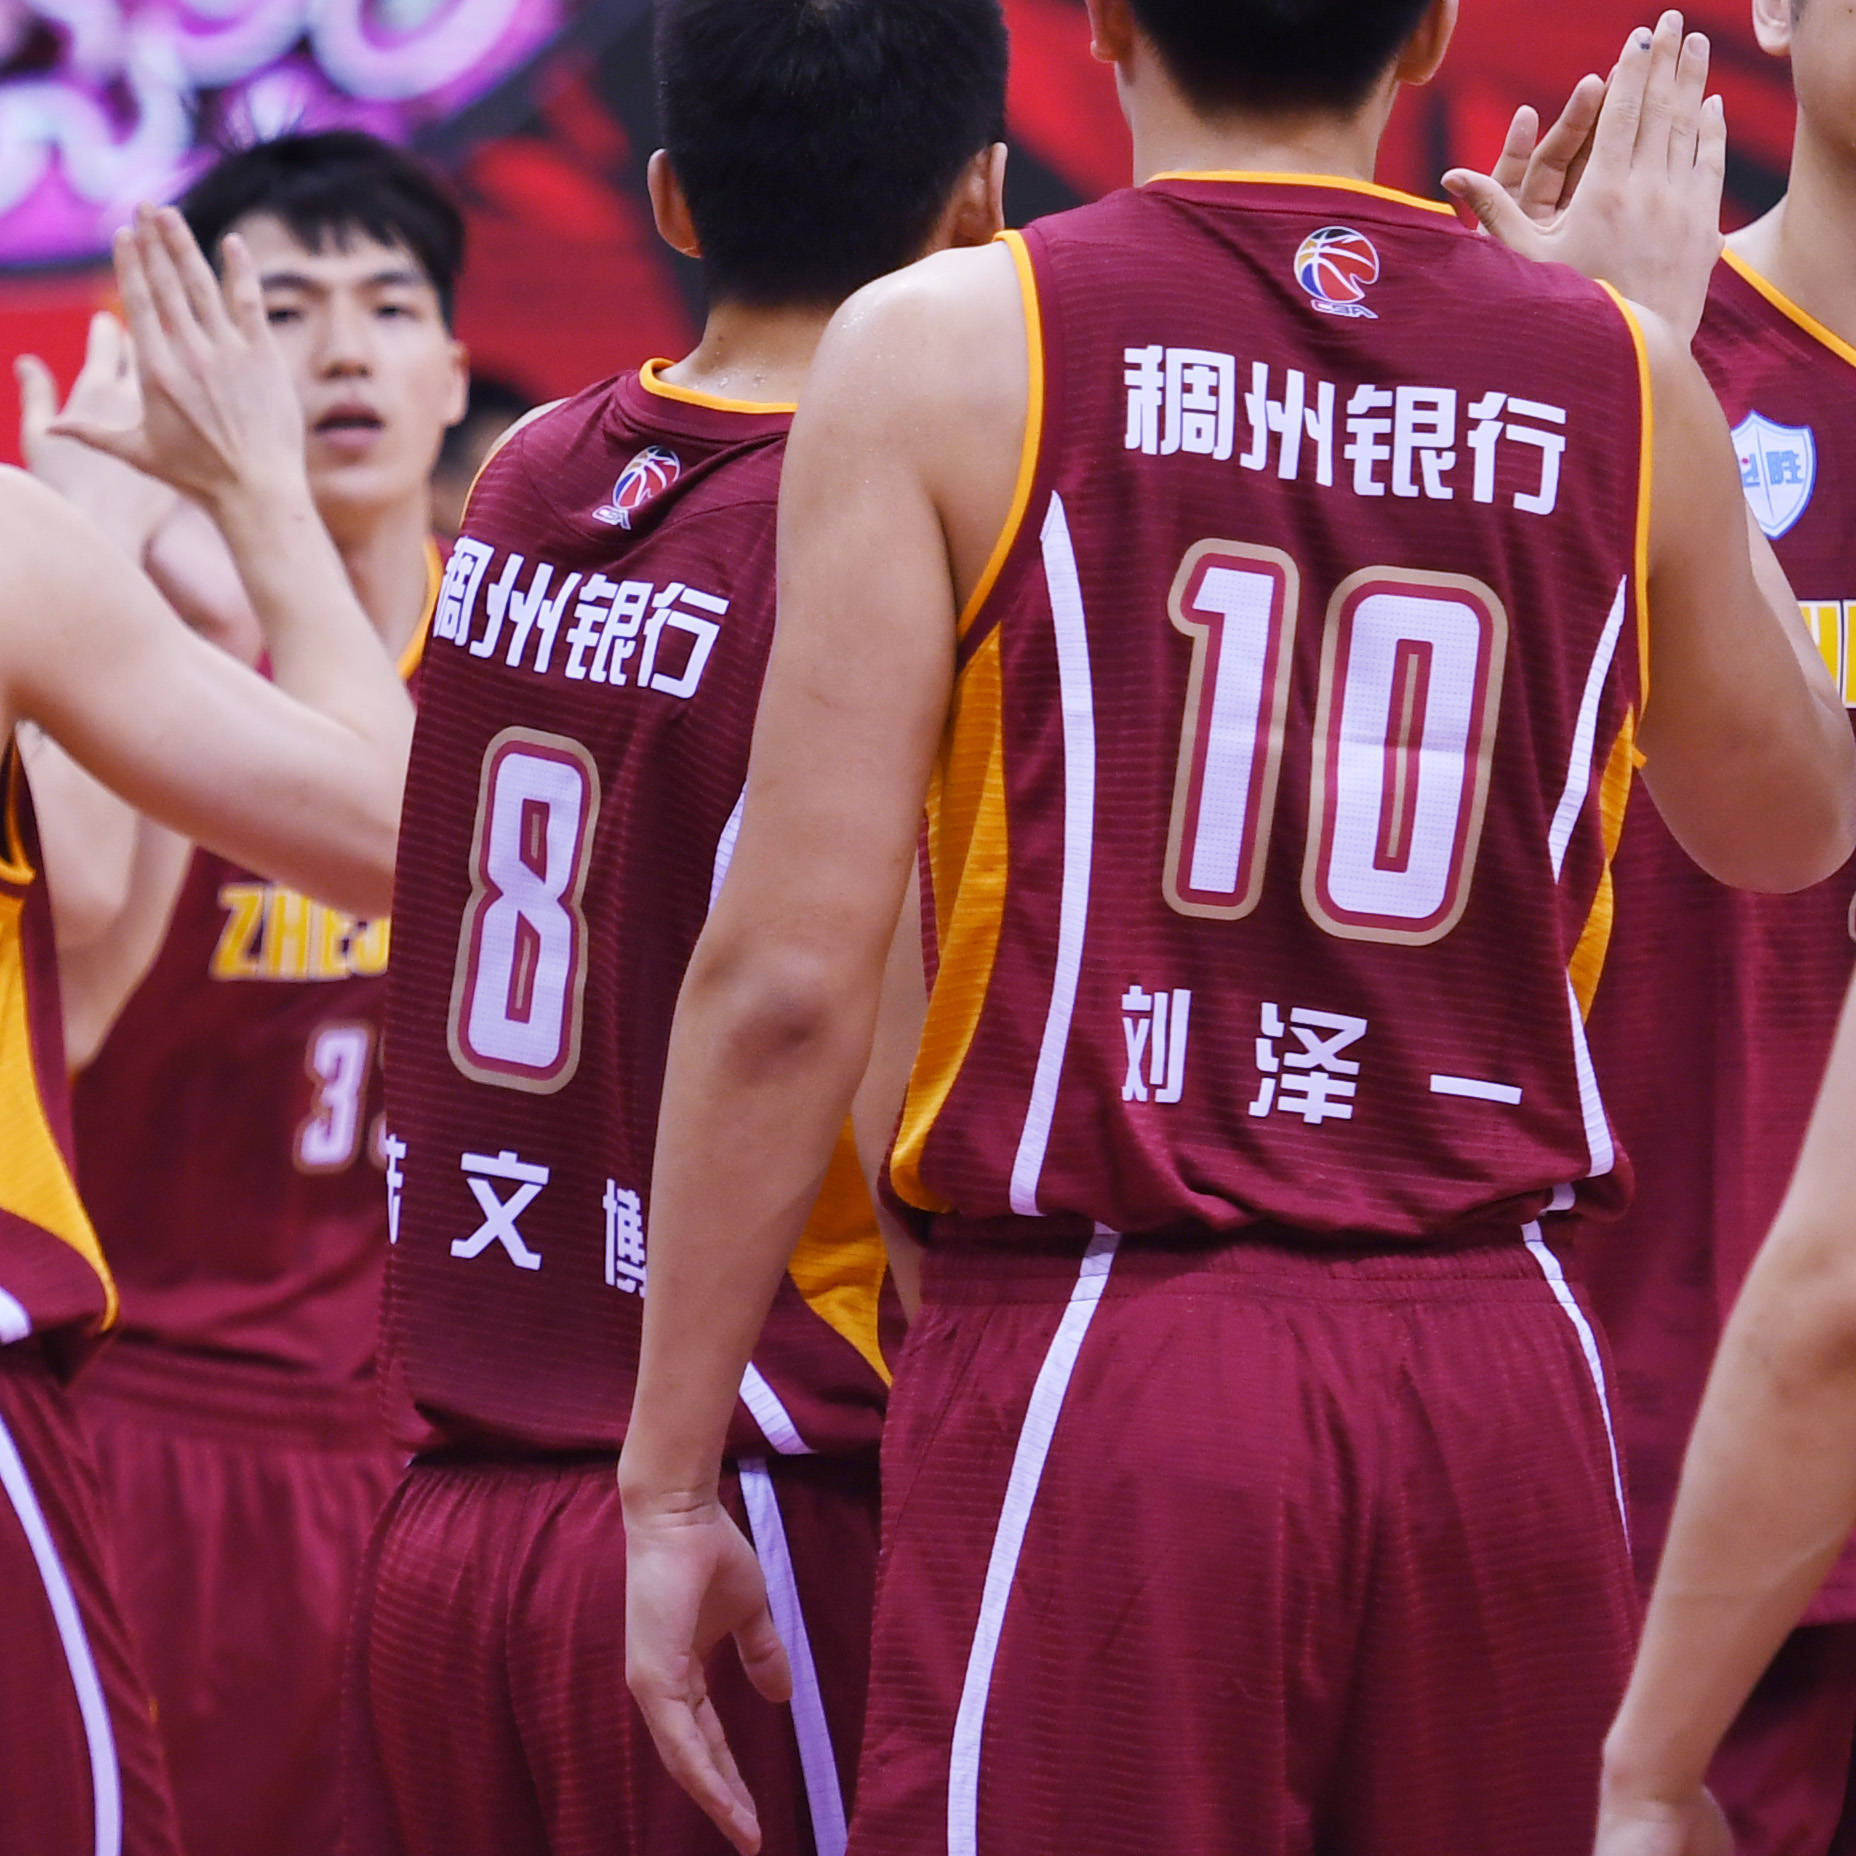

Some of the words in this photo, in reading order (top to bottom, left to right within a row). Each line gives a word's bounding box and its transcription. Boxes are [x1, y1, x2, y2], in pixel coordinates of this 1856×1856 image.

[1123, 344, 1567, 515] 稠州银行
[1165, 541, 1506, 942] 10
[450, 728, 595, 1090] 8
[1121, 984, 1522, 1125] 刘泽一
